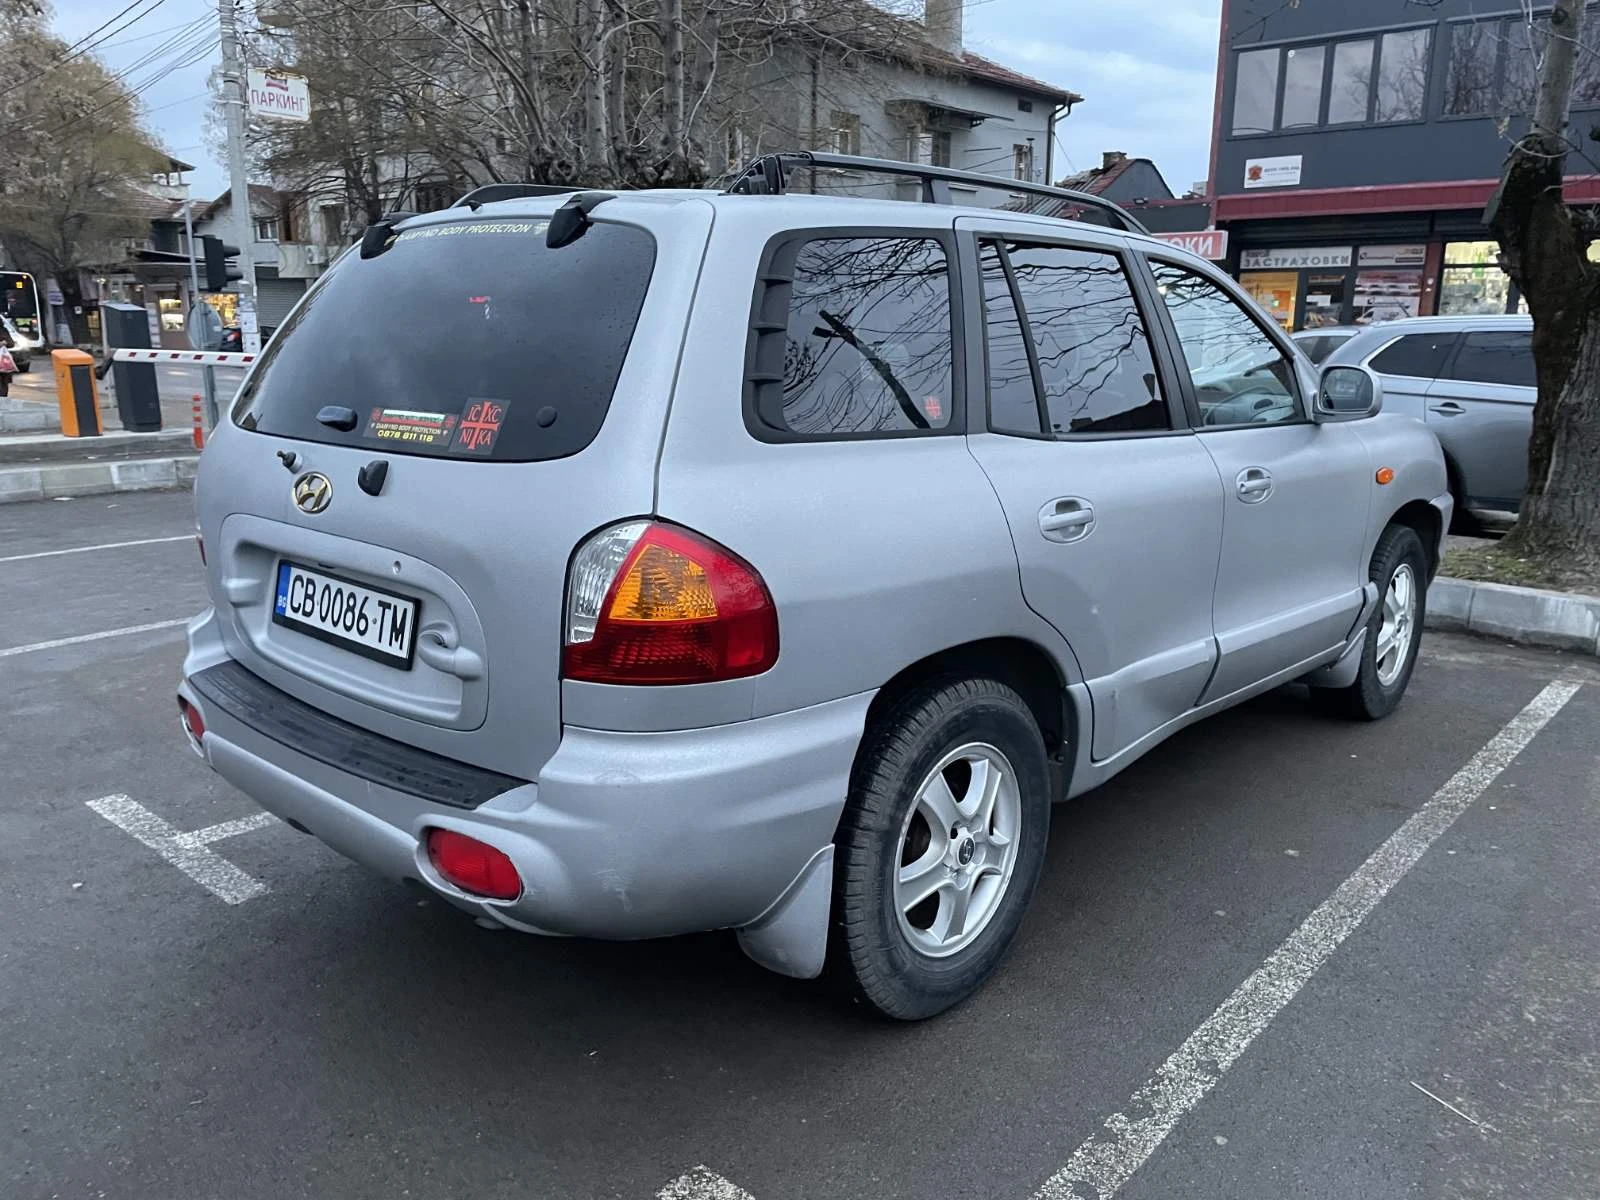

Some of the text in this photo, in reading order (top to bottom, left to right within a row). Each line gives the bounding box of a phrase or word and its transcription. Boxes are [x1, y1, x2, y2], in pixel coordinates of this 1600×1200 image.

[251, 89, 305, 112] ПАРКИНГ
[440, 226, 465, 236] BODY
[466, 224, 531, 234] PROTECTION
[1244, 255, 1350, 268] ЗАСТРАХОВКИ
[377, 429, 434, 443] 0878 811 118
[411, 426, 441, 435] PROTECTION
